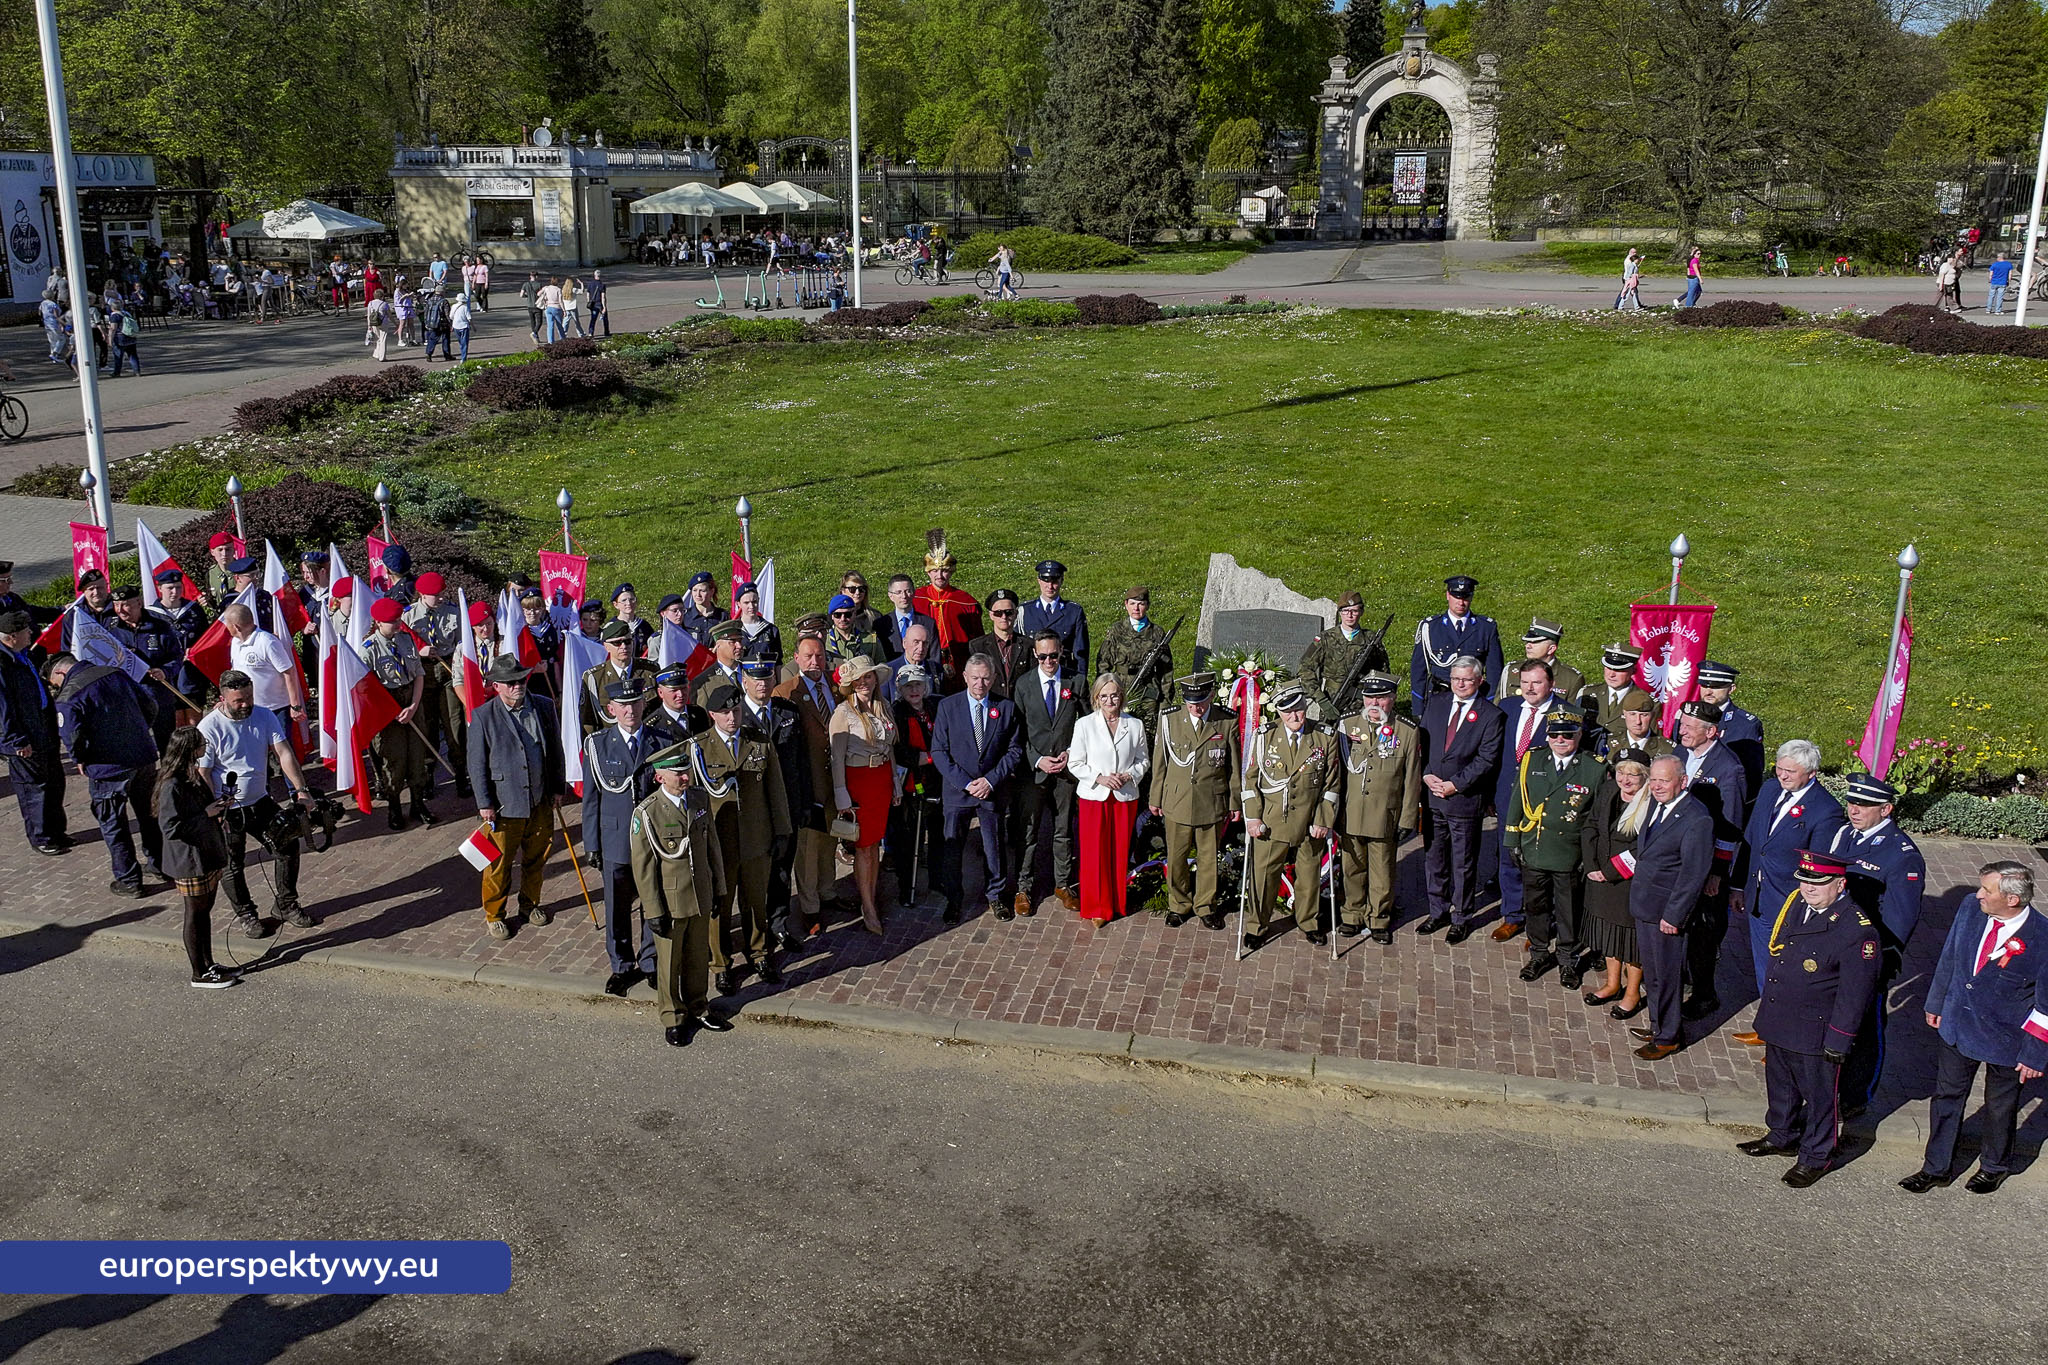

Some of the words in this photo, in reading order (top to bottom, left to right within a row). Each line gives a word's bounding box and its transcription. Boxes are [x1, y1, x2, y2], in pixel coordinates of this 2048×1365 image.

[75, 155, 144, 181] LODY
[496, 182, 522, 191] Garden
[543, 569, 561, 582] Tobie
[561, 566, 580, 588] Polsko
[1638, 626, 1669, 642] Tobie
[1670, 620, 1700, 643] Polsko
